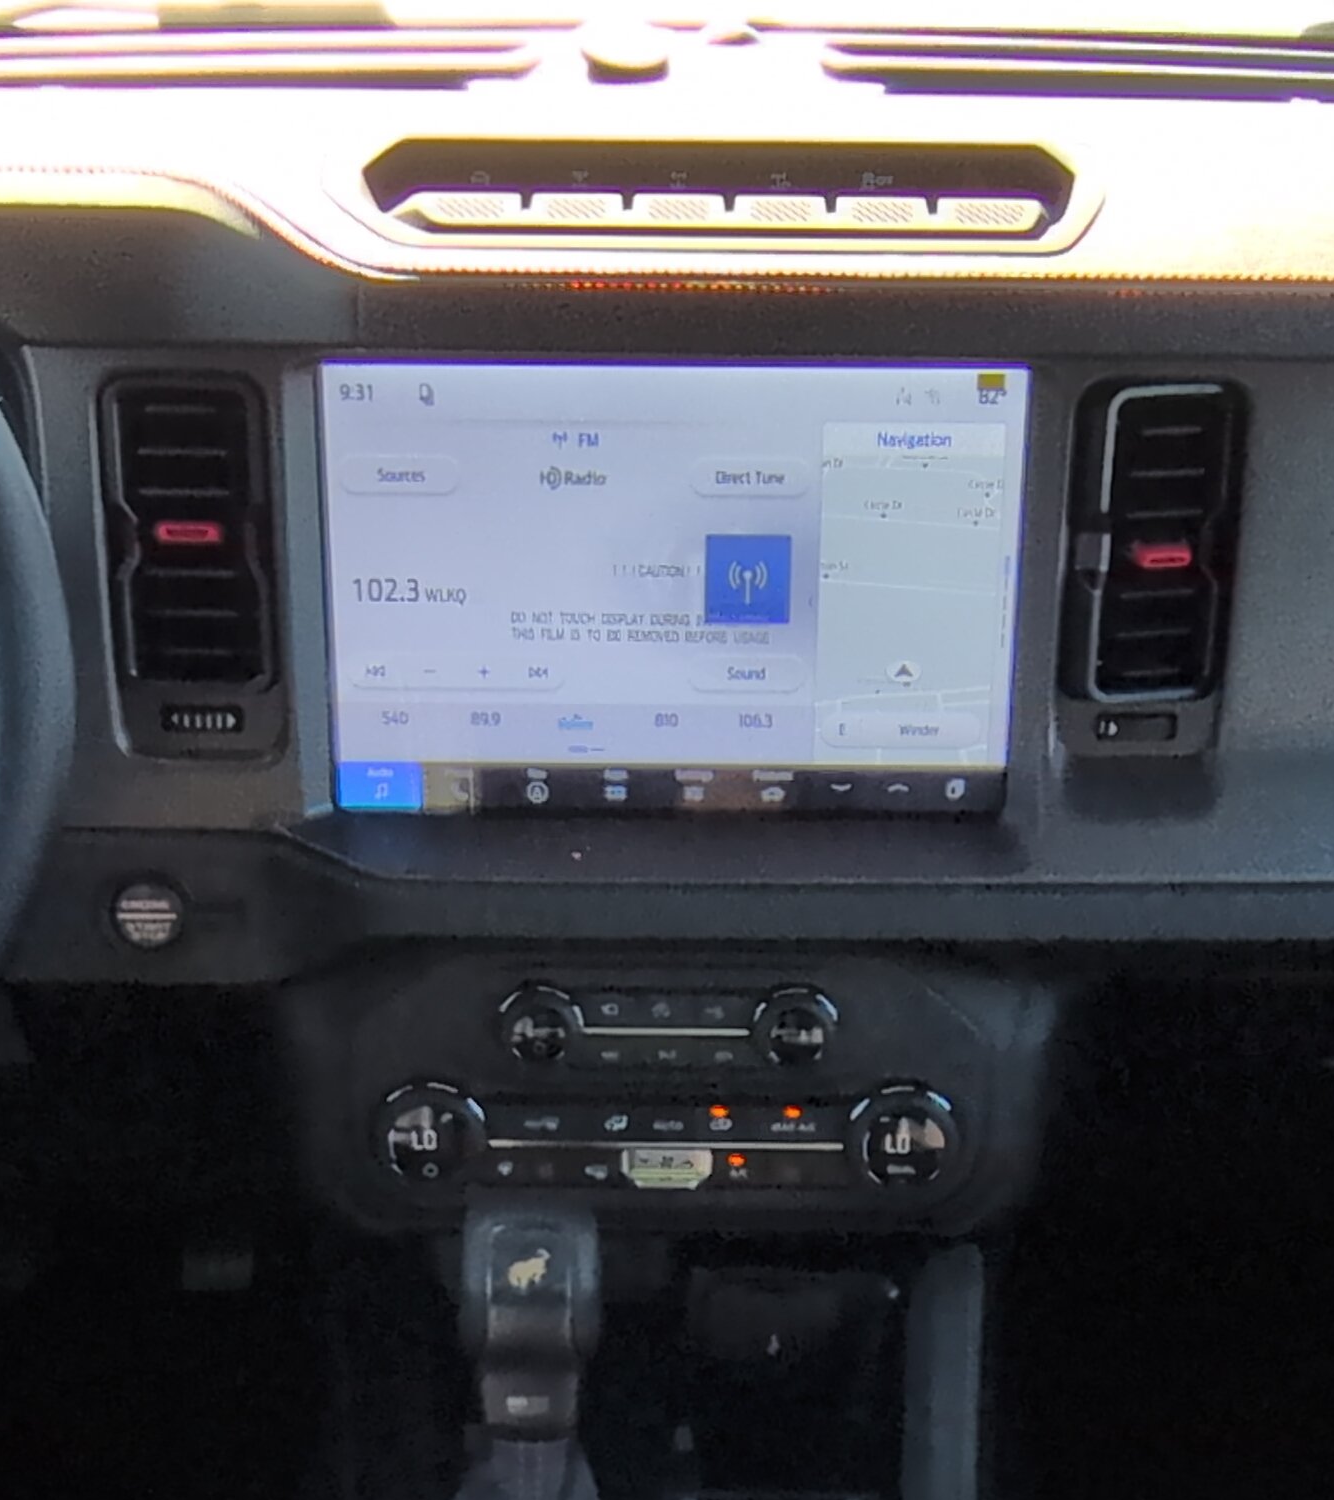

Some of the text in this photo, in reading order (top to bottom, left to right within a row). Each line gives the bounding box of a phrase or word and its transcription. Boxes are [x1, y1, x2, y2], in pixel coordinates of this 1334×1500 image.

[339, 383, 373, 401] 9:31
[578, 432, 600, 447] FM
[877, 432, 952, 448] Navigation
[376, 467, 426, 482] Sources
[715, 471, 785, 486] Direct Tune
[352, 578, 467, 605] 102.3 WLKQ
[510, 611, 526, 624] DO
[532, 611, 553, 625] NOT
[559, 612, 596, 625] TOUCH
[601, 612, 644, 626] DISPLAY
[649, 613, 690, 626] DURING
[512, 628, 535, 641] THIS
[540, 628, 564, 642] FILM
[587, 629, 602, 643] TO
[627, 630, 680, 644] REMOVED
[684, 631, 728, 644] BEFORE
[733, 631, 771, 645] USAGE
[727, 666, 767, 681] Sound
[738, 713, 773, 729] 106.3
[898, 723, 940, 737] Winder
[410, 1128, 438, 1152] LO
[884, 1131, 911, 1155] LO
